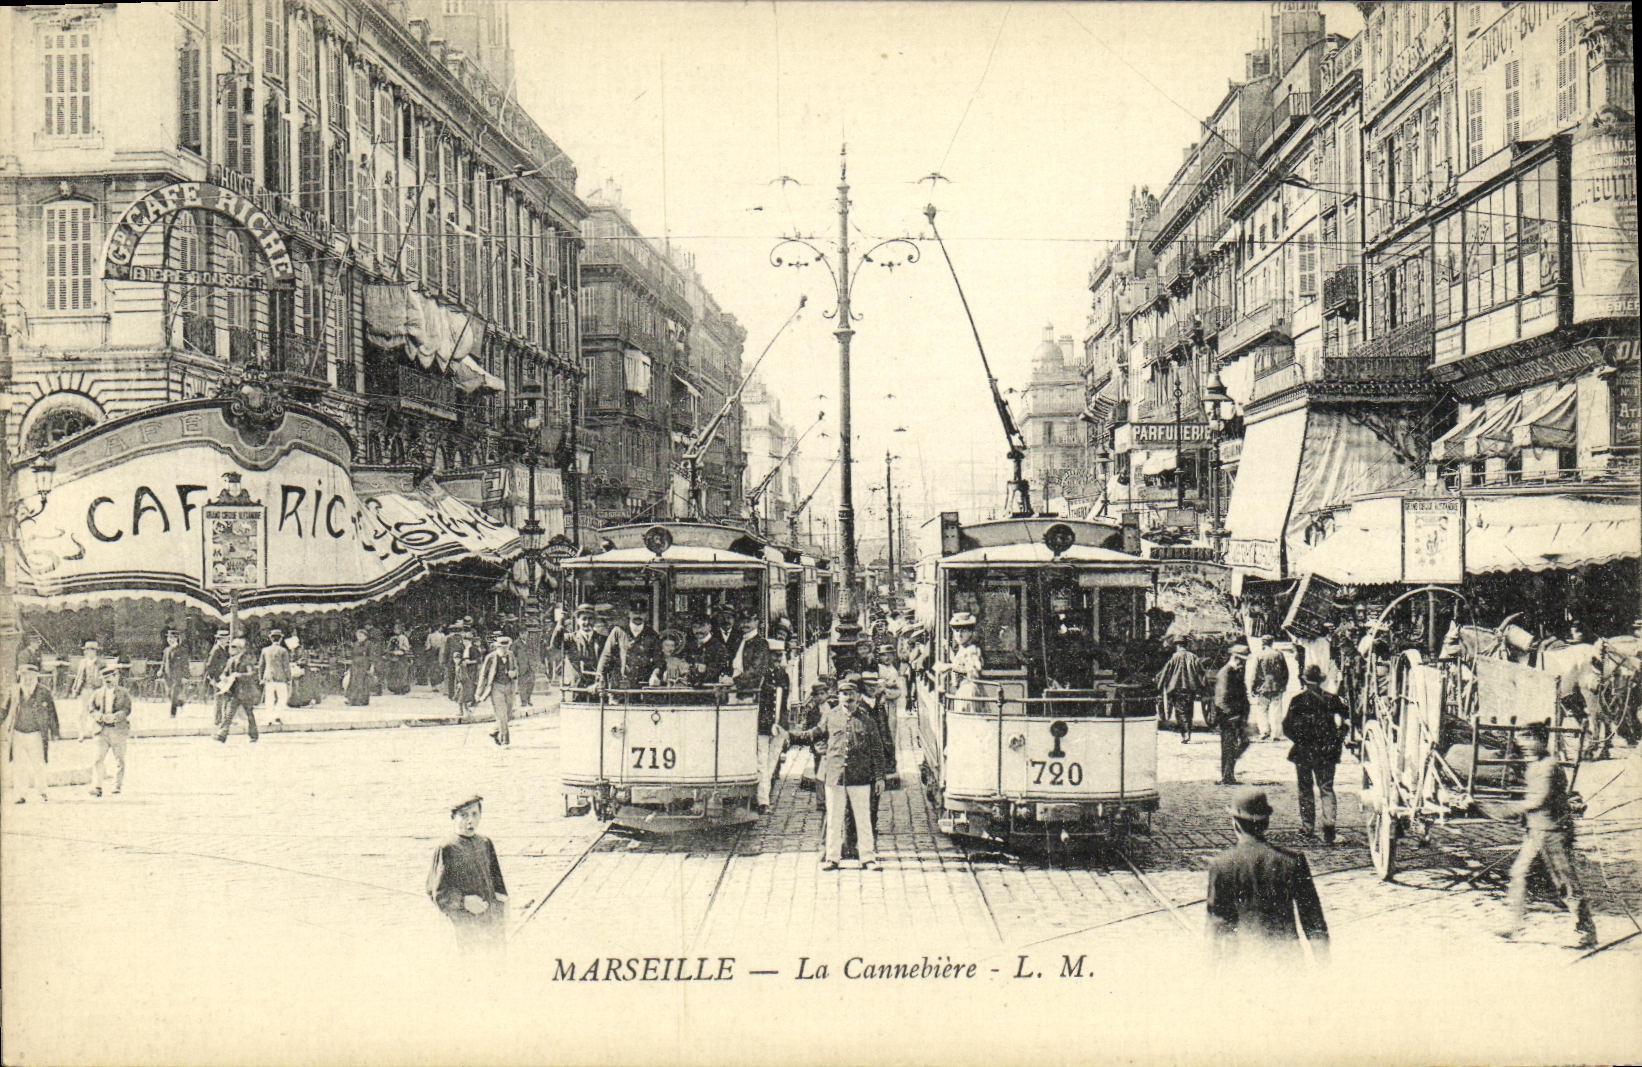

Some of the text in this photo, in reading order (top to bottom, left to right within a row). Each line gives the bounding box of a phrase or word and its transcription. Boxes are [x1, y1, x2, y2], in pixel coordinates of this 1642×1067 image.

[125, 183, 201, 233] CAFE
[215, 187, 294, 279] RICHE
[134, 268, 187, 284] BIERE
[86, 484, 208, 542] CAF
[631, 747, 676, 770] 719
[1031, 760, 1084, 785] 720
